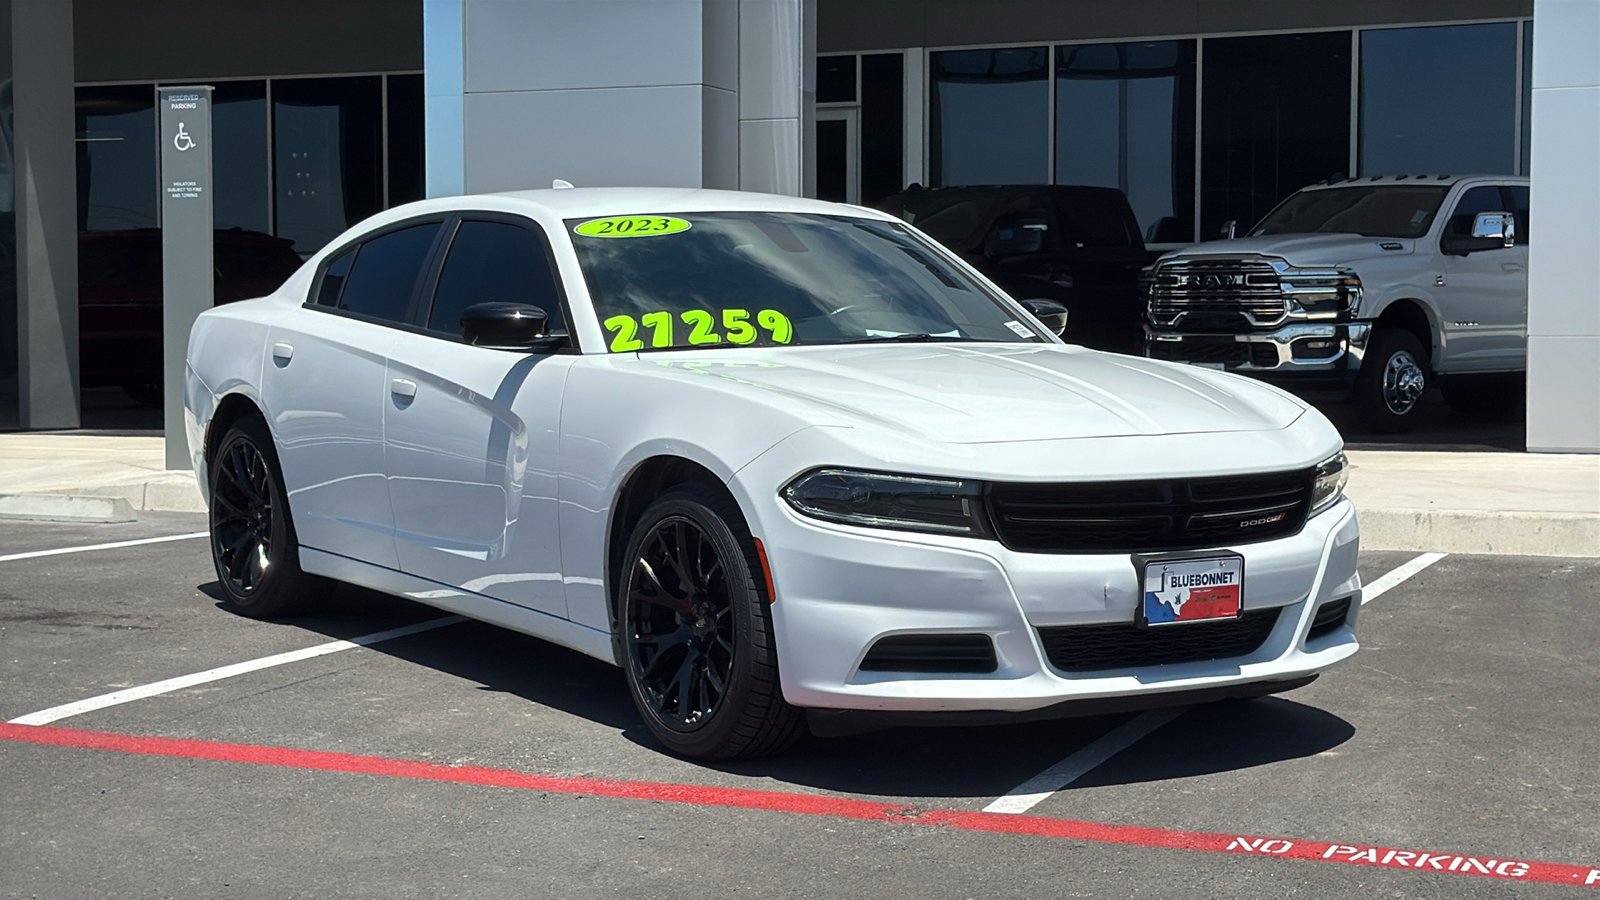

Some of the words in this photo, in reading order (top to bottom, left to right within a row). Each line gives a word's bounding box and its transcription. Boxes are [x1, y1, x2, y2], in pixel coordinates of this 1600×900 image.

[597, 218, 671, 235] 2023
[1181, 275, 1244, 286] RAM
[604, 309, 793, 352] 27259
[1240, 515, 1282, 527] DODGE
[1171, 571, 1234, 588] BLUEBONNET
[1226, 837, 1294, 854] NO
[1322, 844, 1530, 877] PARKING
